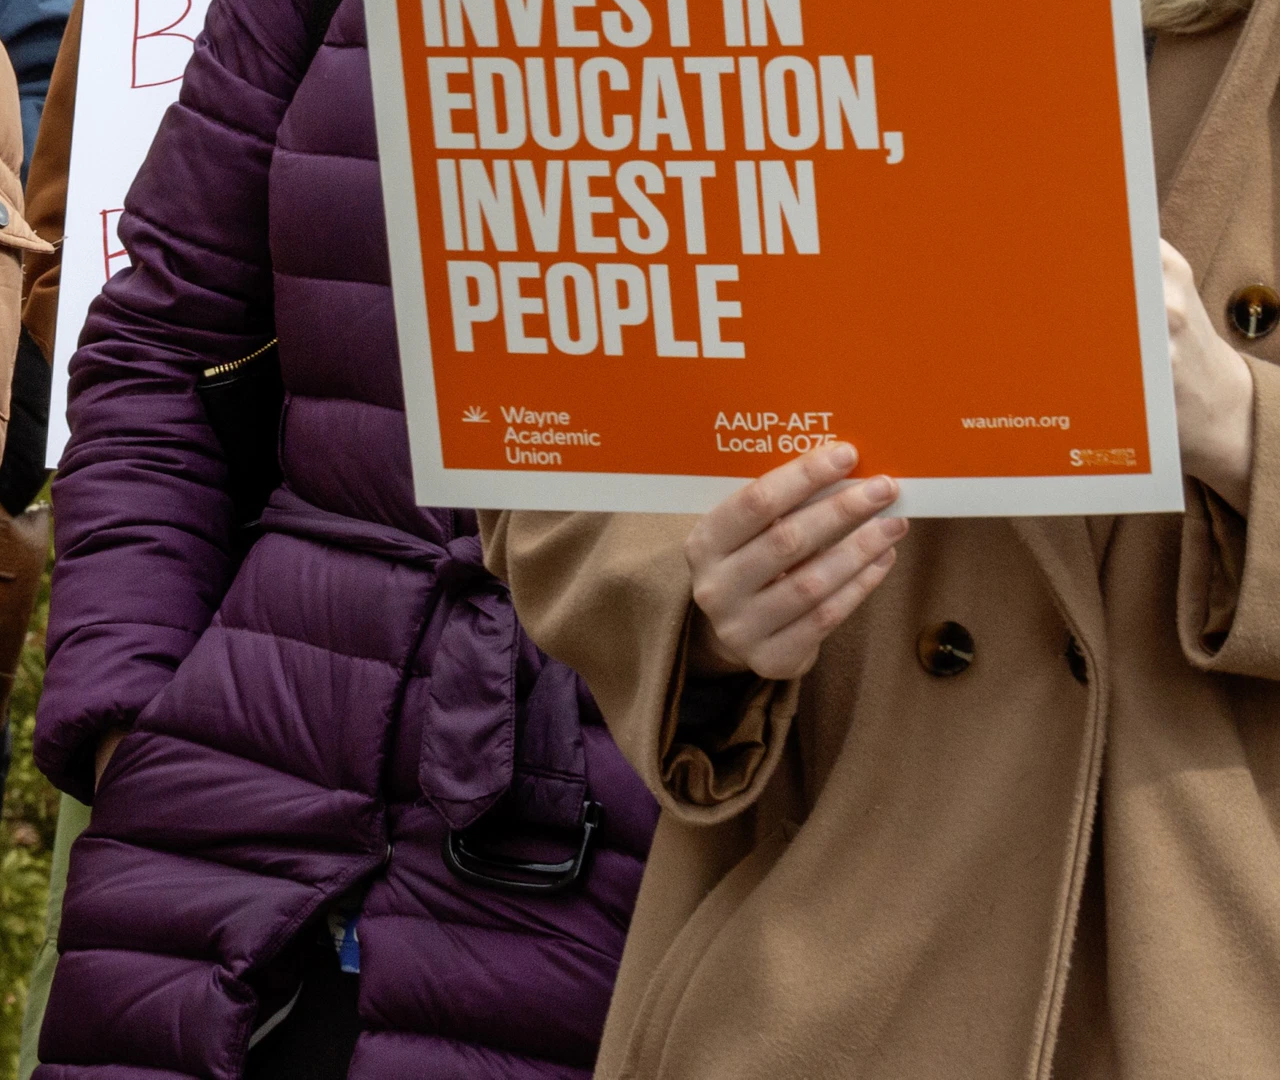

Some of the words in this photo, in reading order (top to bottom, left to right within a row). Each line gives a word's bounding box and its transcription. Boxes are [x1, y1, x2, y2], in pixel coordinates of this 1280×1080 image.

[426, 55, 905, 165] EDUCATION,
[436, 158, 717, 255] INVEST
[735, 159, 821, 255] IN
[445, 259, 746, 359] PEOPLE
[500, 405, 571, 427] Wayne
[713, 411, 833, 431] AAUP-AFT
[960, 414, 1071, 431] waunion.org
[503, 426, 602, 447] Academic
[715, 432, 773, 453] Local
[505, 446, 563, 466] Union
